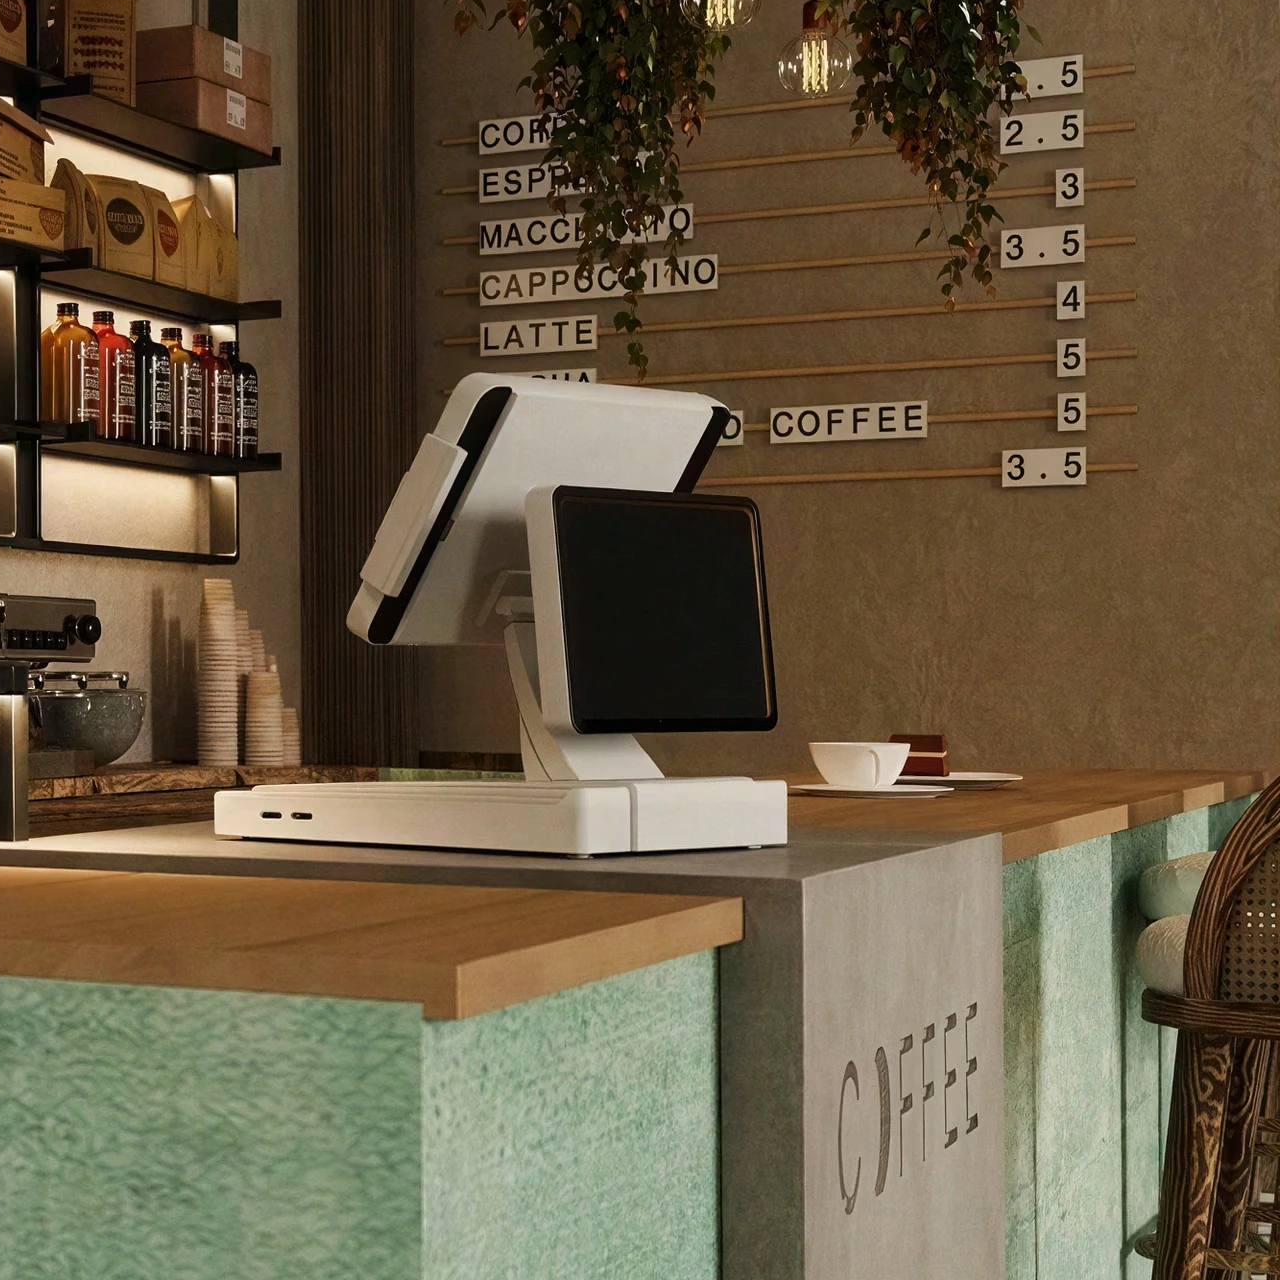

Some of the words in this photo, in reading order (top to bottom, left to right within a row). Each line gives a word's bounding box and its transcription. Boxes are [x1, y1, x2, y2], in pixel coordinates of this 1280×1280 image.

[1004, 114, 1080, 147] 2.5
[1060, 172, 1079, 200] 3
[1005, 229, 1080, 261] 3.5
[483, 319, 593, 350] LATTE
[1061, 285, 1081, 312] 4
[1062, 343, 1081, 370] 5
[772, 404, 923, 438] COFFEE
[1063, 398, 1082, 425] 5
[1006, 451, 1082, 481] 3.5
